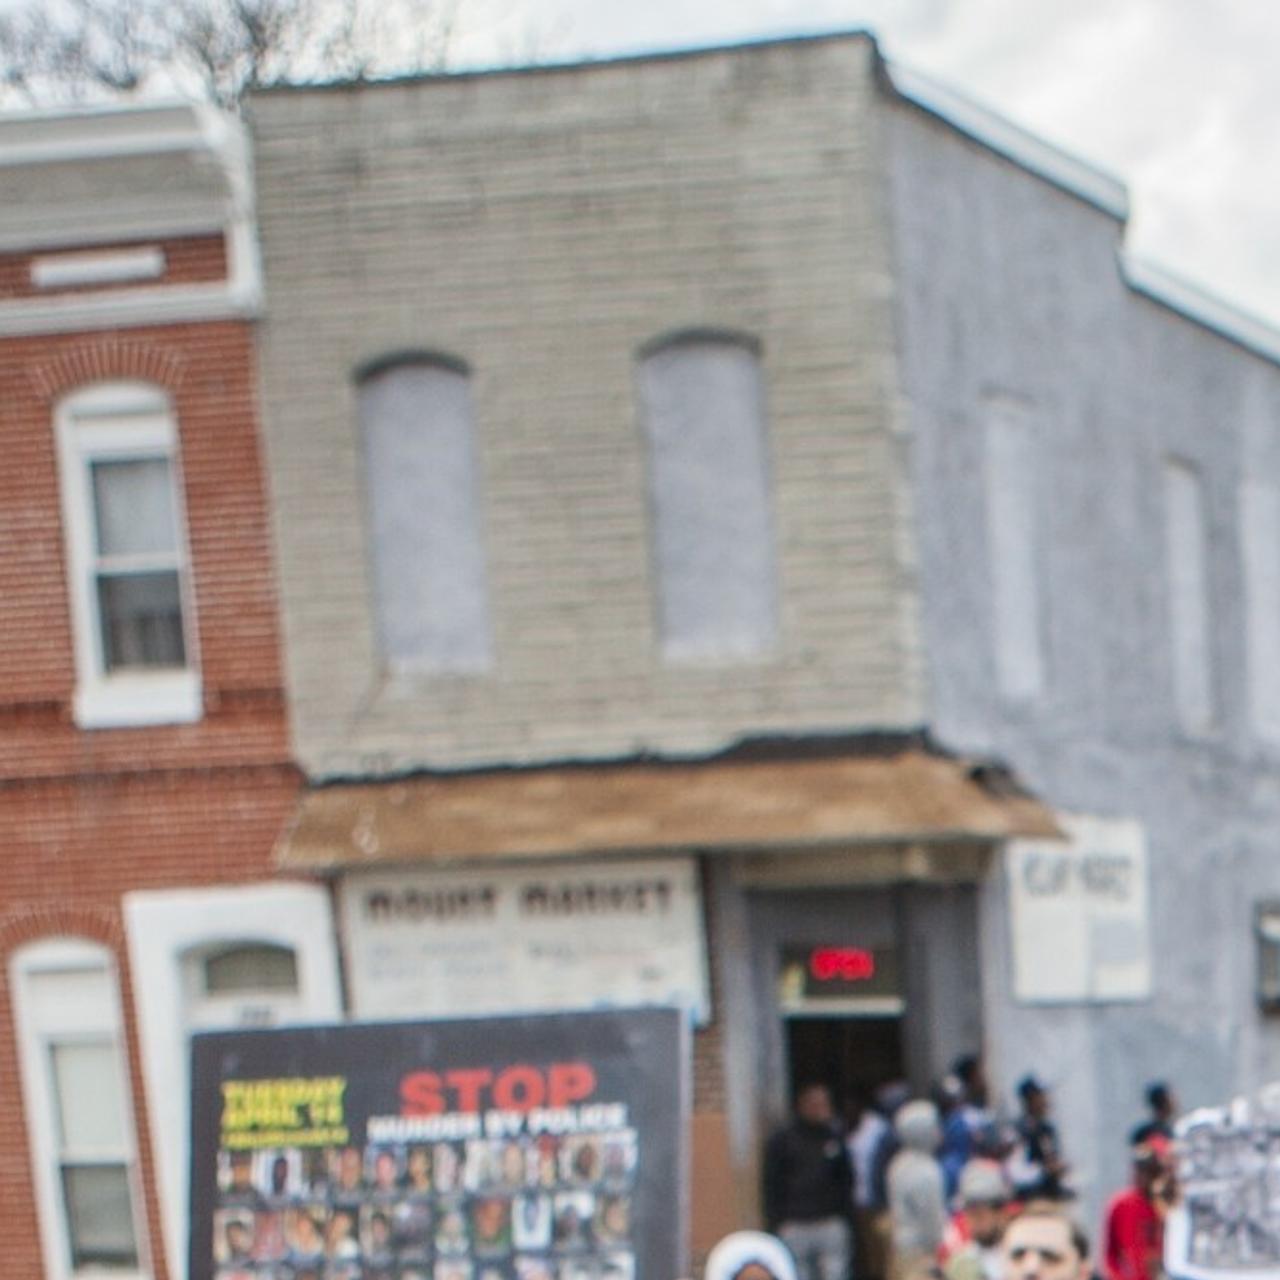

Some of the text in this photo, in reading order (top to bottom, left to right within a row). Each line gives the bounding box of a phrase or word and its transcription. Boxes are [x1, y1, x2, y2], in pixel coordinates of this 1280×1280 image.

[401, 1063, 597, 1119] STOP
[367, 1113, 481, 1143] MURDER
[485, 1108, 526, 1135] BY
[528, 1102, 629, 1133] POLICE
